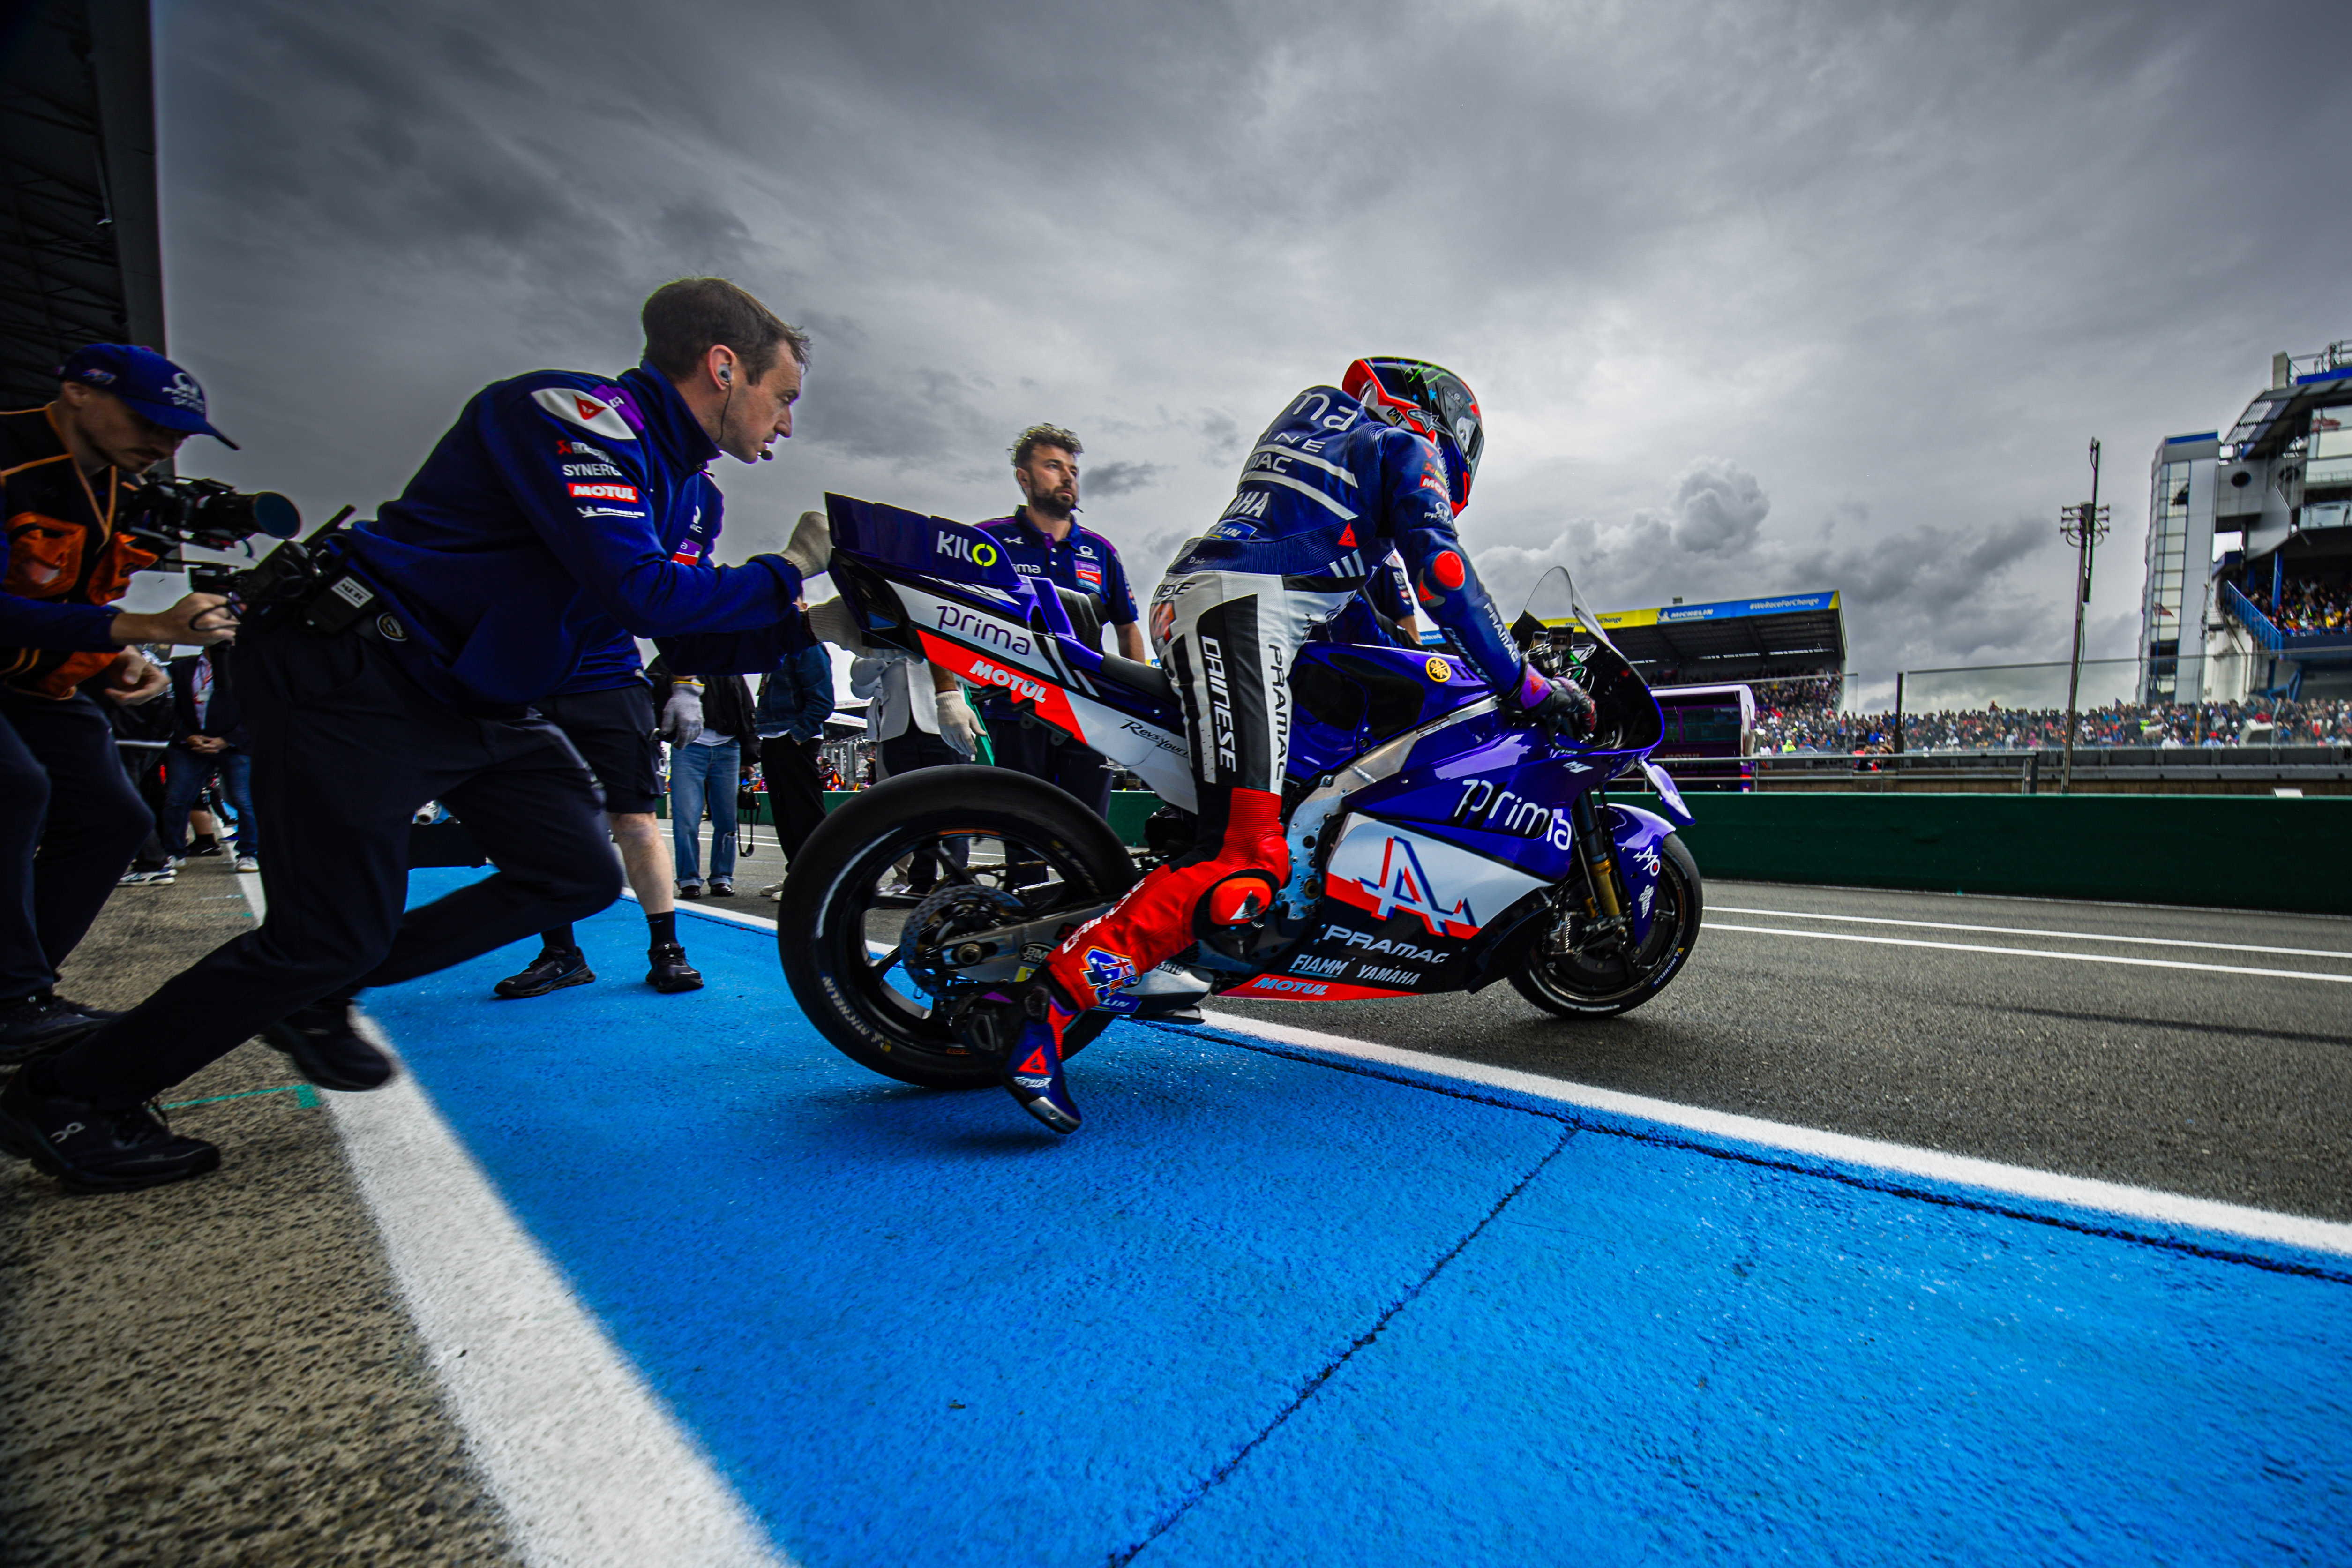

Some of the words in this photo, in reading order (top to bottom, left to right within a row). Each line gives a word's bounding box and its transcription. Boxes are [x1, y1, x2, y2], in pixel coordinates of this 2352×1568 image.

[1386, 406, 1405, 426] CAT
[573, 485, 636, 500] MOTUL
[936, 530, 997, 567] KILO
[936, 606, 1031, 655] prima
[1671, 608, 1714, 618] MICHELIN
[1483, 602, 1521, 663] PRAMAC
[969, 660, 1047, 703] MOTUL
[1201, 636, 1236, 772] DAINESE
[1268, 644, 1288, 780] PRAMAC
[1119, 719, 1161, 743] Revs
[1454, 779, 1572, 850] prima
[1322, 924, 1450, 964] PRAMAC
[1253, 977, 1329, 996] MOTUL
[1291, 954, 1350, 975] FIAMM
[1356, 964, 1421, 985] YAMAHA
[1654, 957, 1677, 985] MICHELIN
